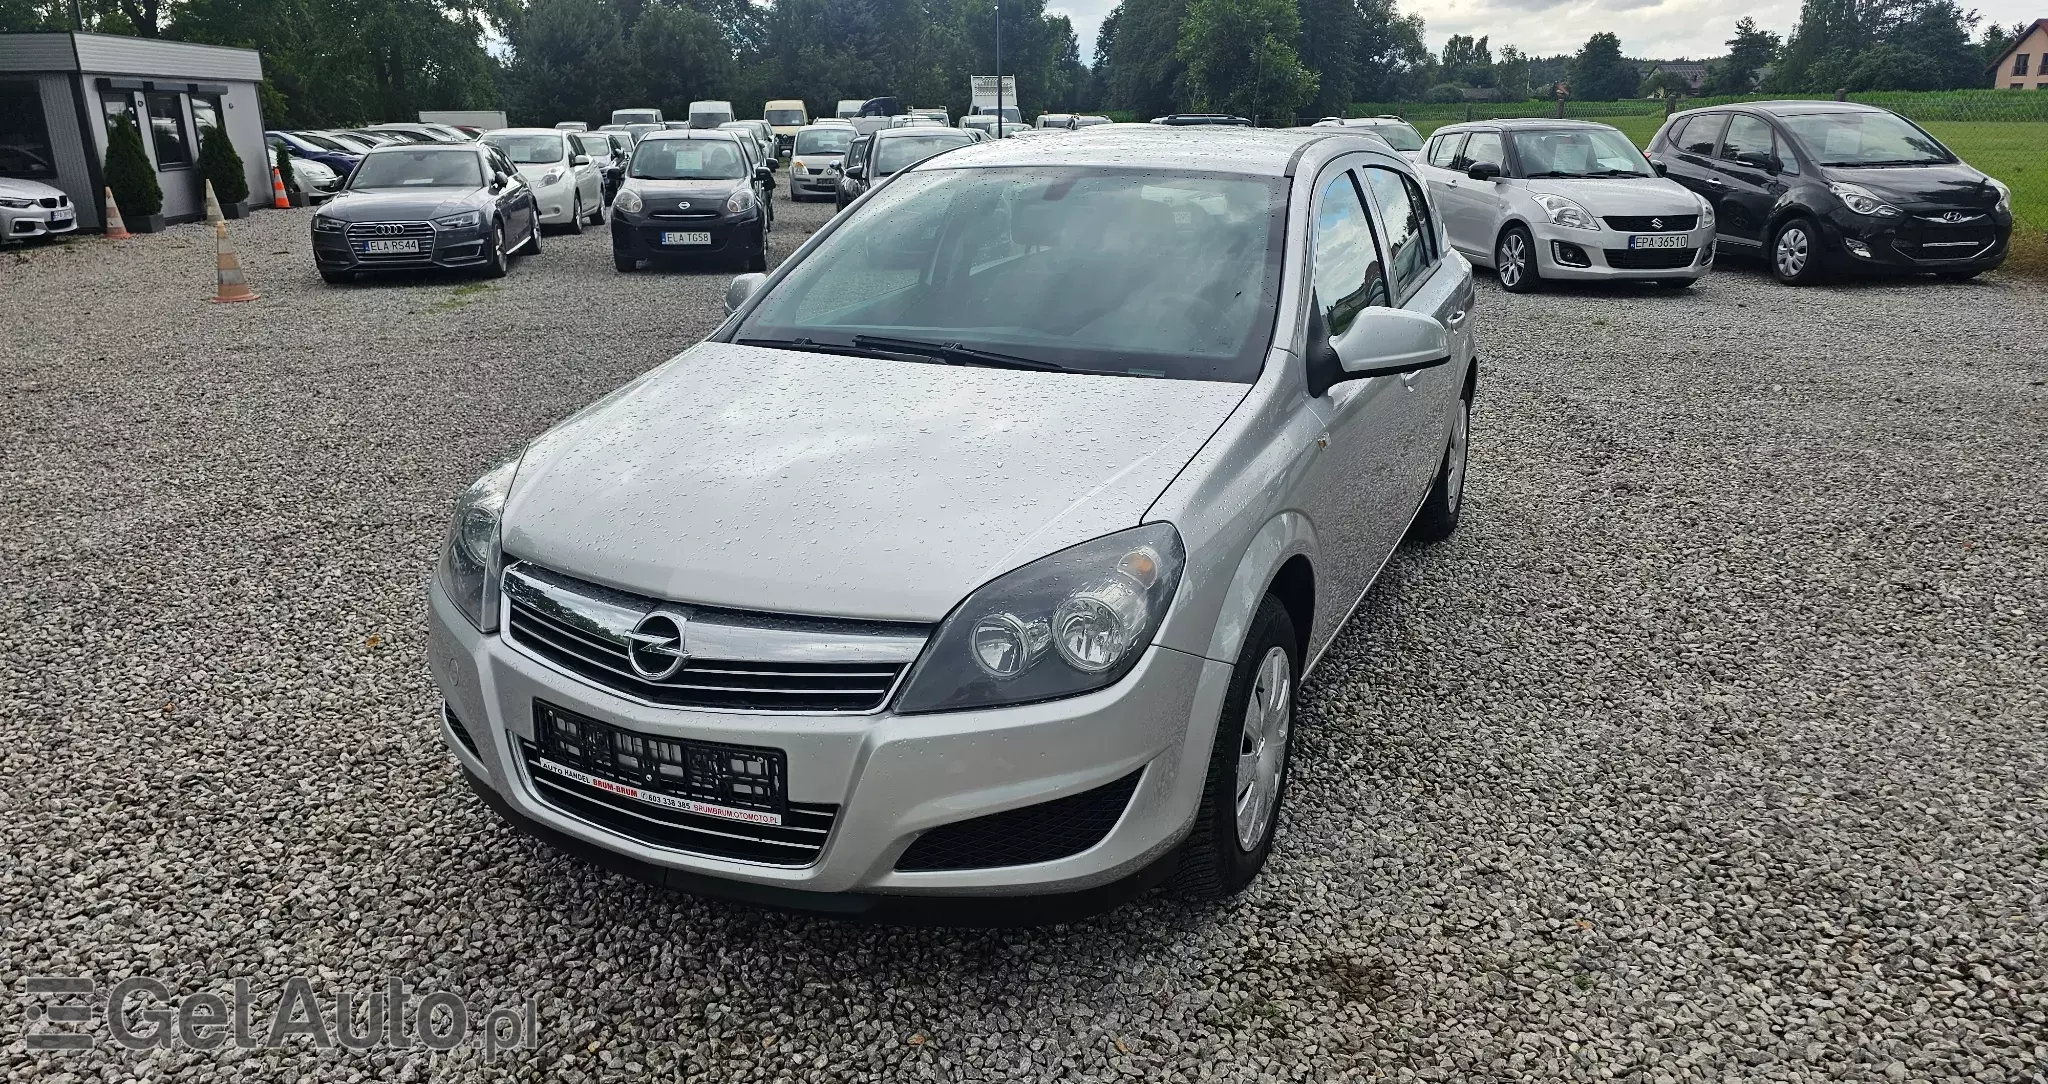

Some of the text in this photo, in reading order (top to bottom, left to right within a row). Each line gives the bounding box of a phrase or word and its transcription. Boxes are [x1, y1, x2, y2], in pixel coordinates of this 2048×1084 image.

[667, 233, 709, 243] ELA TG58
[1635, 236, 1687, 248] EPA 36510
[370, 240, 417, 251] ELA RS44
[542, 763, 563, 776] AUTO
[564, 768, 591, 784] HANDEL
[592, 778, 639, 798] BRUM-BRUM
[663, 797, 676, 807] 338
[677, 799, 691, 810] 385
[693, 804, 779, 824] BRUMBRUM.OTOMOTO.PL
